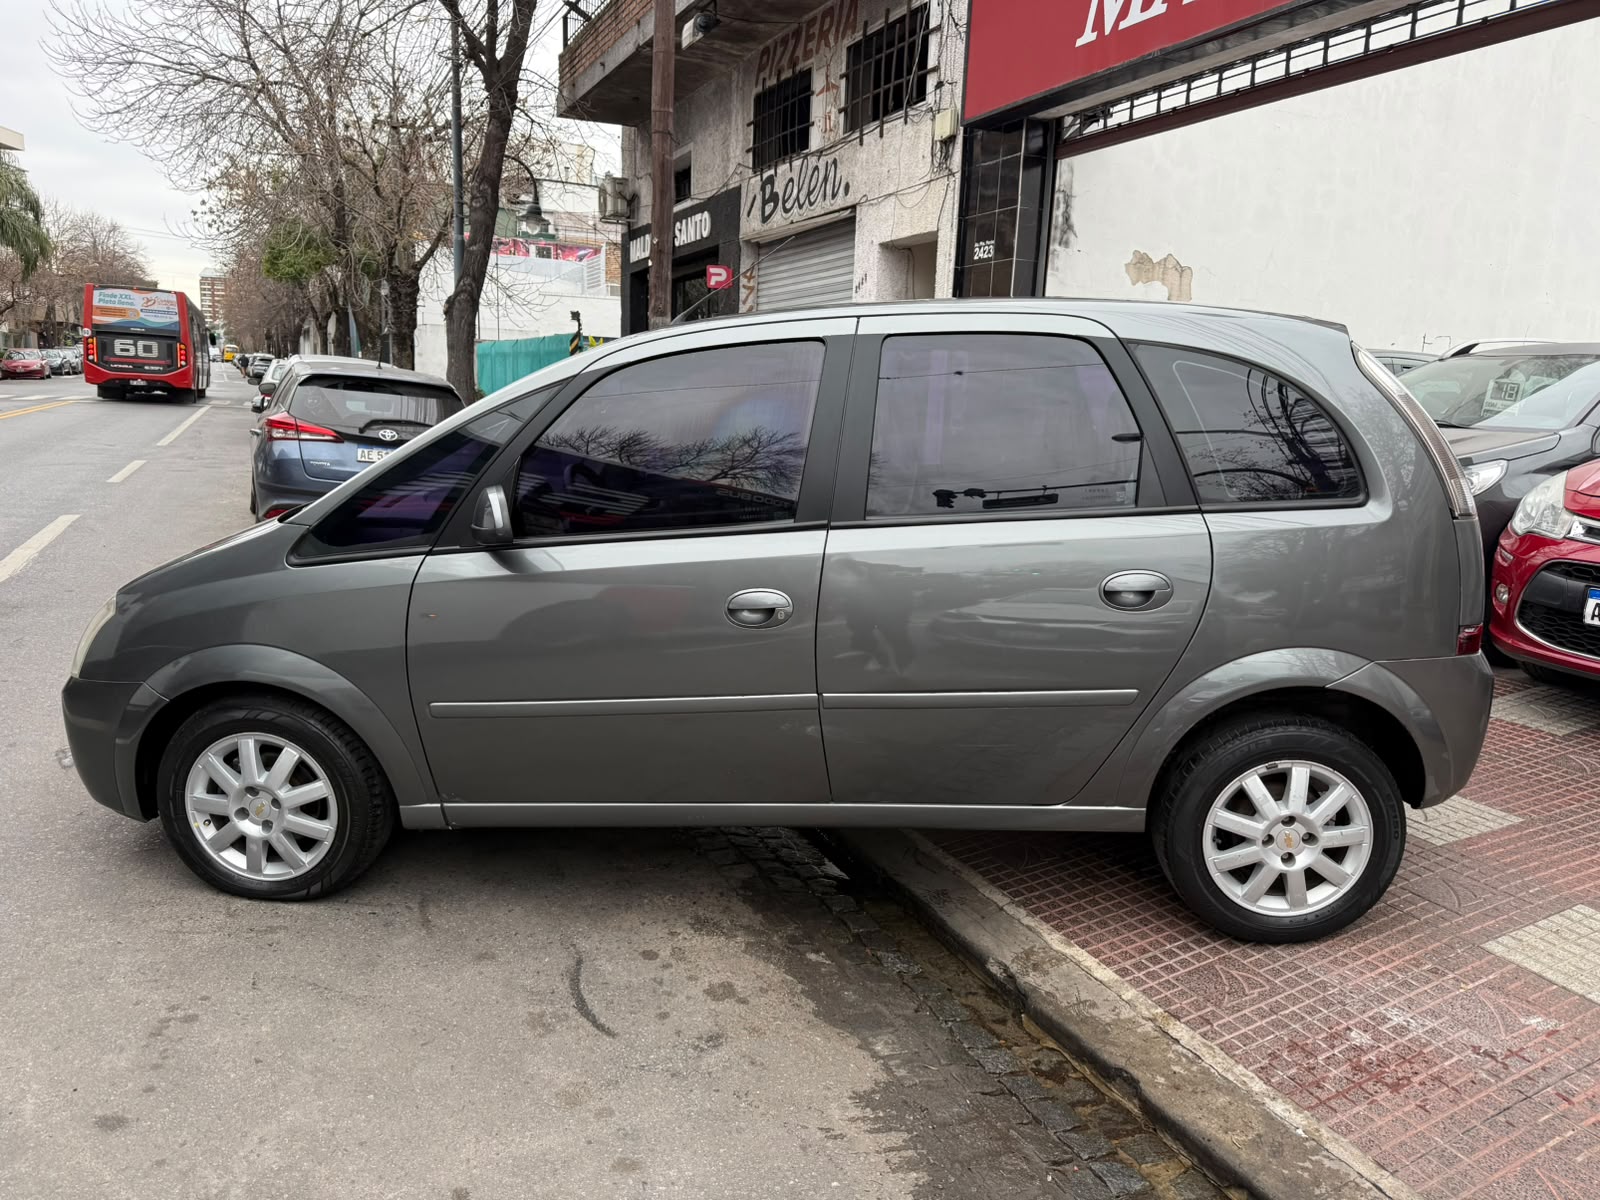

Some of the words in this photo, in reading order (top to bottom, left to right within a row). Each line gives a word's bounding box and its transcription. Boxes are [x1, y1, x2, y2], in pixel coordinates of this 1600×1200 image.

[755, 0, 858, 88] PIZZERIA
[674, 211, 711, 247] SANTO
[974, 245, 994, 259] 2423
[114, 339, 159, 357] 60
[361, 450, 374, 460] AE
